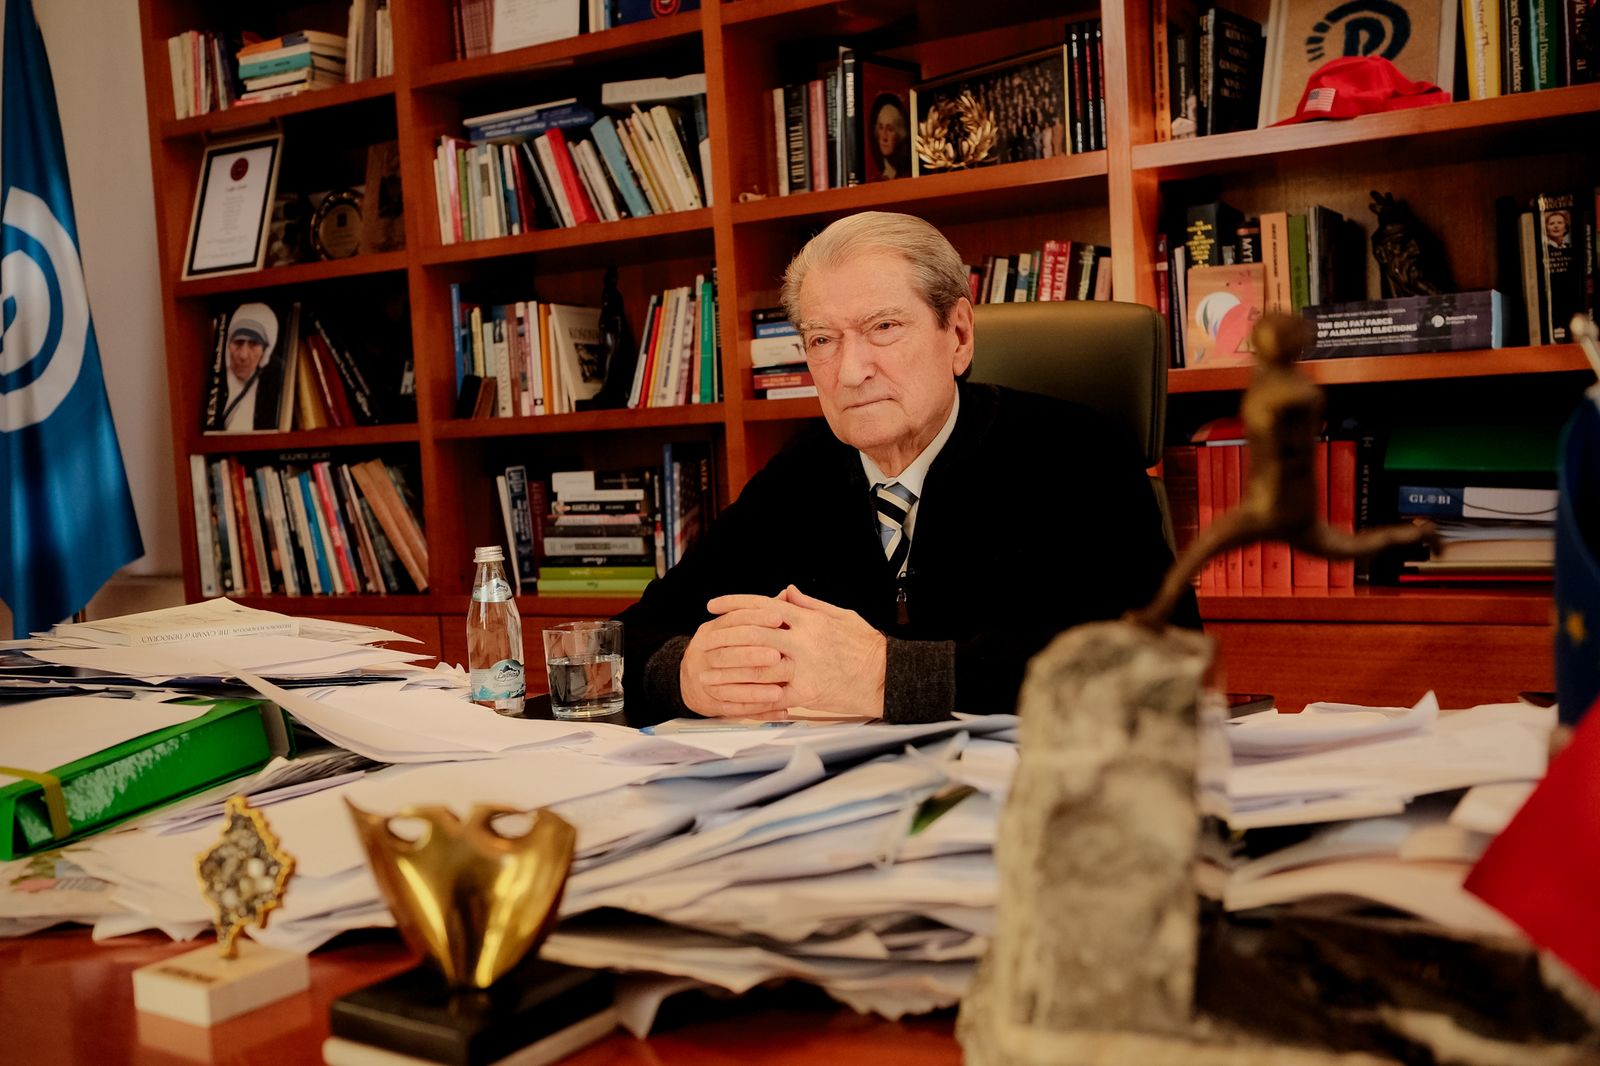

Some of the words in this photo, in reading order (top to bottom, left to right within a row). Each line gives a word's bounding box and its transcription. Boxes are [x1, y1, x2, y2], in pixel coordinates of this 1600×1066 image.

[1509, 17, 1524, 92] Correspondence
[1317, 322, 1332, 330] THE
[1333, 320, 1348, 329] BIG
[1349, 319, 1365, 328] FAT
[1366, 317, 1393, 327] FARCE
[1317, 330, 1329, 338] OF
[1329, 326, 1371, 337] ALBANIAN
[1372, 323, 1418, 334] ELECTIONS
[1408, 494, 1451, 504] GLOBI
[141, 633, 183, 644] DEMOCRACY
